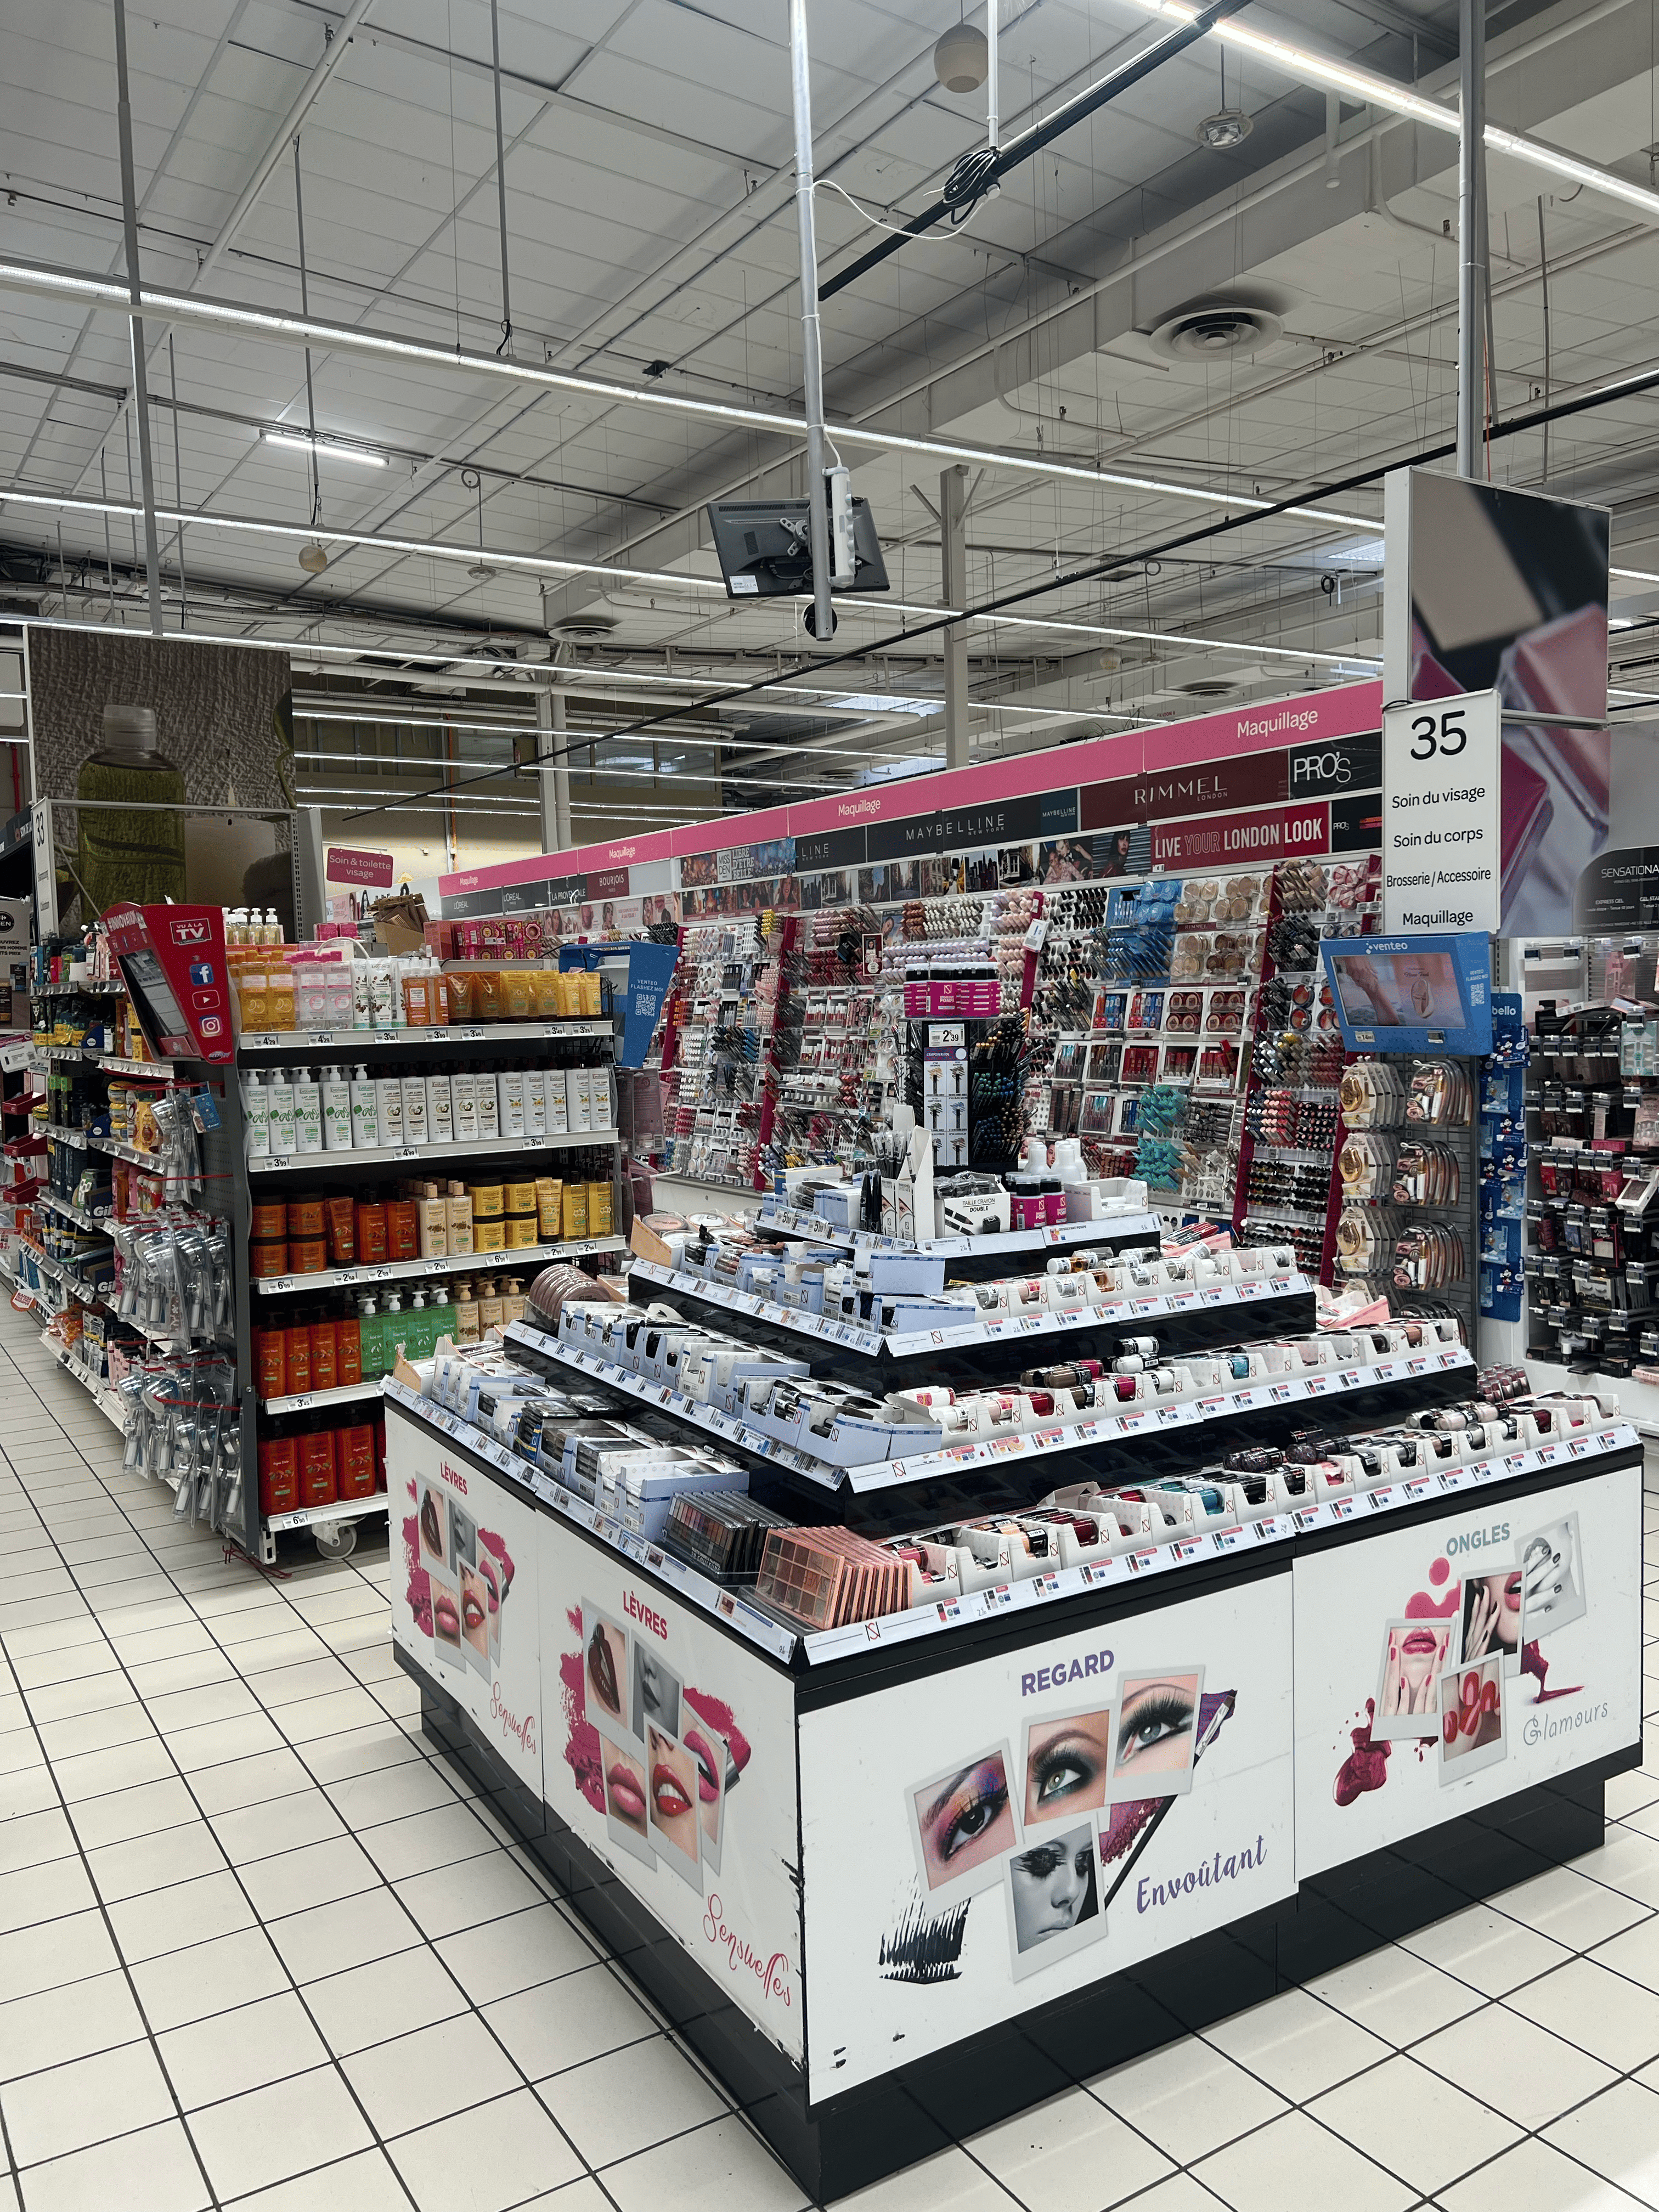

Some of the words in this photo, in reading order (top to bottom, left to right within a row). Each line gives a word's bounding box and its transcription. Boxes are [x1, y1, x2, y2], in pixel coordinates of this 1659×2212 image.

[1237, 710, 1318, 738] Maquillage
[1410, 710, 1467, 760] 35
[1135, 776, 1227, 804] RIMMEL
[1197, 792, 1228, 801] LONDON
[1392, 794, 1420, 809] Soin
[1422, 790, 1440, 805] du
[1442, 786, 1486, 805] visage
[838, 799, 881, 817] Maquillage
[1042, 807, 1076, 817] MAYBELLINE
[36, 811, 44, 847] 33
[906, 814, 1005, 840] MAYBELLINE
[1155, 837, 1181, 859] LIVE
[1184, 832, 1220, 855] YOUR
[1224, 823, 1279, 850] LONDON
[1284, 818, 1322, 843] LOOK
[1393, 834, 1421, 848] Soin
[1424, 831, 1441, 845] du
[1443, 829, 1483, 847] corps
[329, 855, 349, 865] Soin
[359, 859, 391, 870] toilette
[609, 846, 636, 859] Maquillage
[732, 847, 750, 859] LIBRE
[346, 868, 374, 879] visage
[460, 876, 478, 886] Maquillage
[599, 875, 624, 887] BOURJOIS
[1387, 873, 1430, 888] Brosserie
[1432, 872, 1436, 888] /
[1437, 867, 1491, 884] Accessoire
[1403, 910, 1474, 931] Maquillage
[176, 927, 205, 940] TV
[1373, 943, 1408, 951] venteo
[1492, 1006, 1516, 1016] bello
[440, 1461, 467, 1496] LÈVRES
[1447, 1523, 1510, 1556] ONGLES
[623, 1591, 667, 1640] LÈVRES
[1022, 1650, 1115, 1697] REGARD
[490, 1682, 535, 1754] Sensuelles
[1523, 1702, 1608, 1746] Glamours
[1137, 1835, 1267, 1914] Envoûtant
[703, 1894, 790, 2006] Sensuelles
